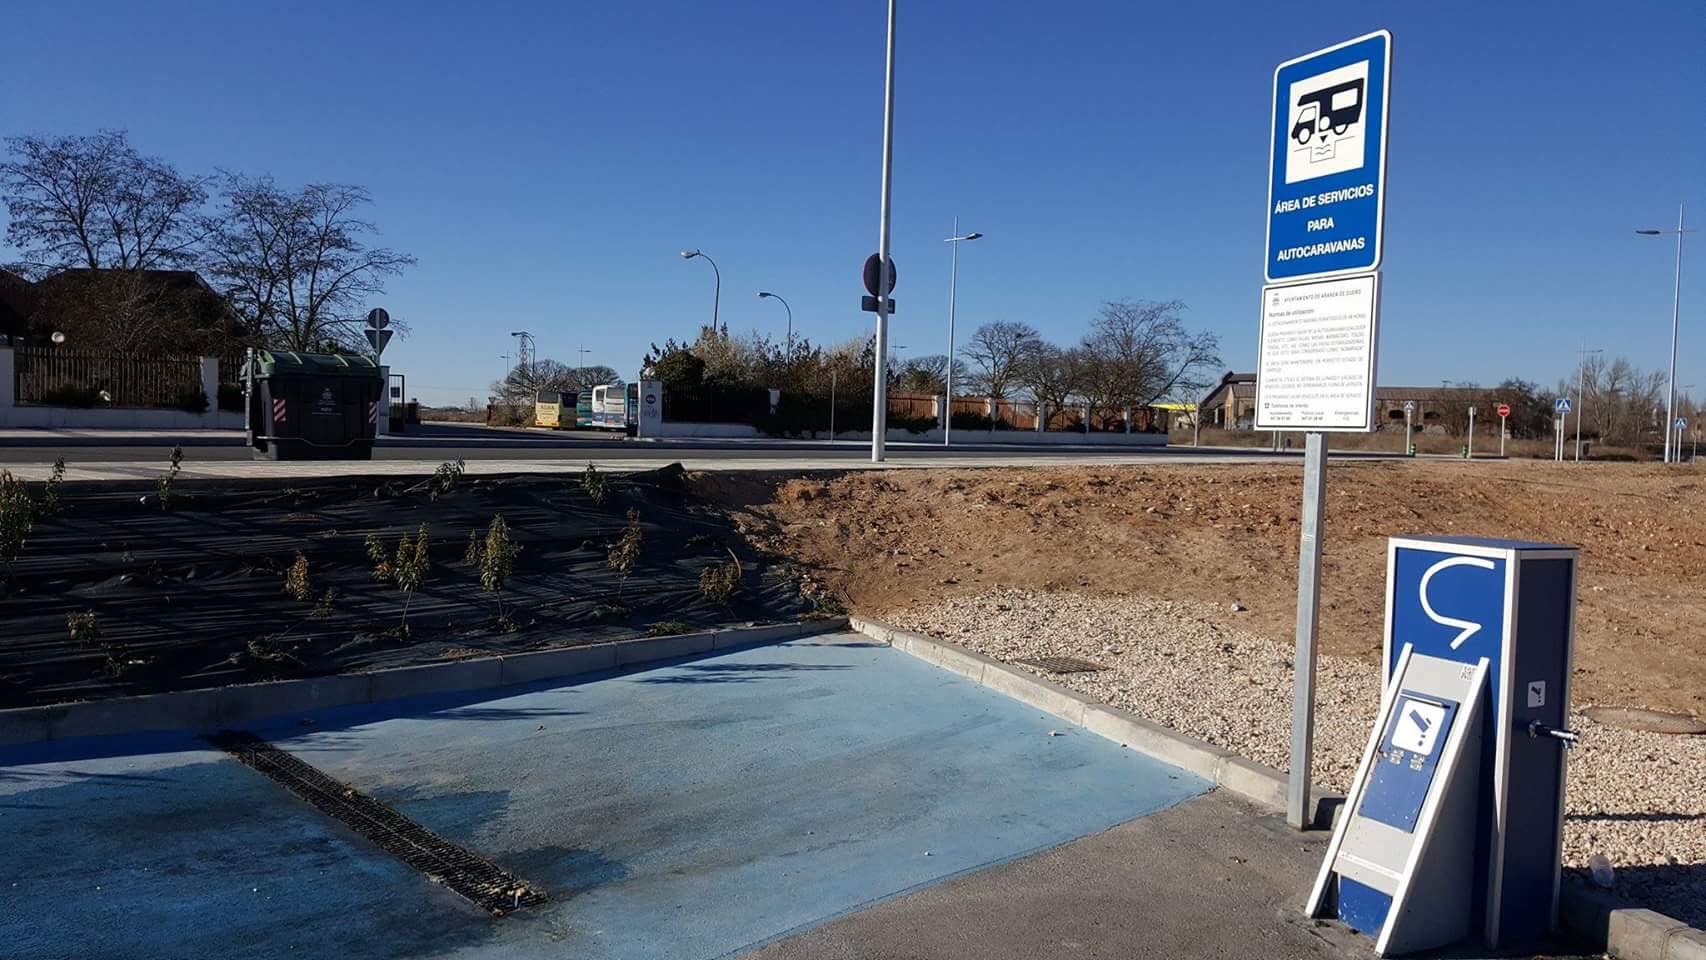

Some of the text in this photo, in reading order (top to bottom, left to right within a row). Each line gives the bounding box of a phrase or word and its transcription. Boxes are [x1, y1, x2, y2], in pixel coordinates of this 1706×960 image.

[1302, 195, 1316, 209] DE
[1318, 183, 1374, 206] SERVICIOS
[1307, 217, 1334, 232] PARA
[1277, 237, 1365, 262] AUTOCARAVANAS
[1284, 294, 1314, 303] AYUNTAMIENTO
